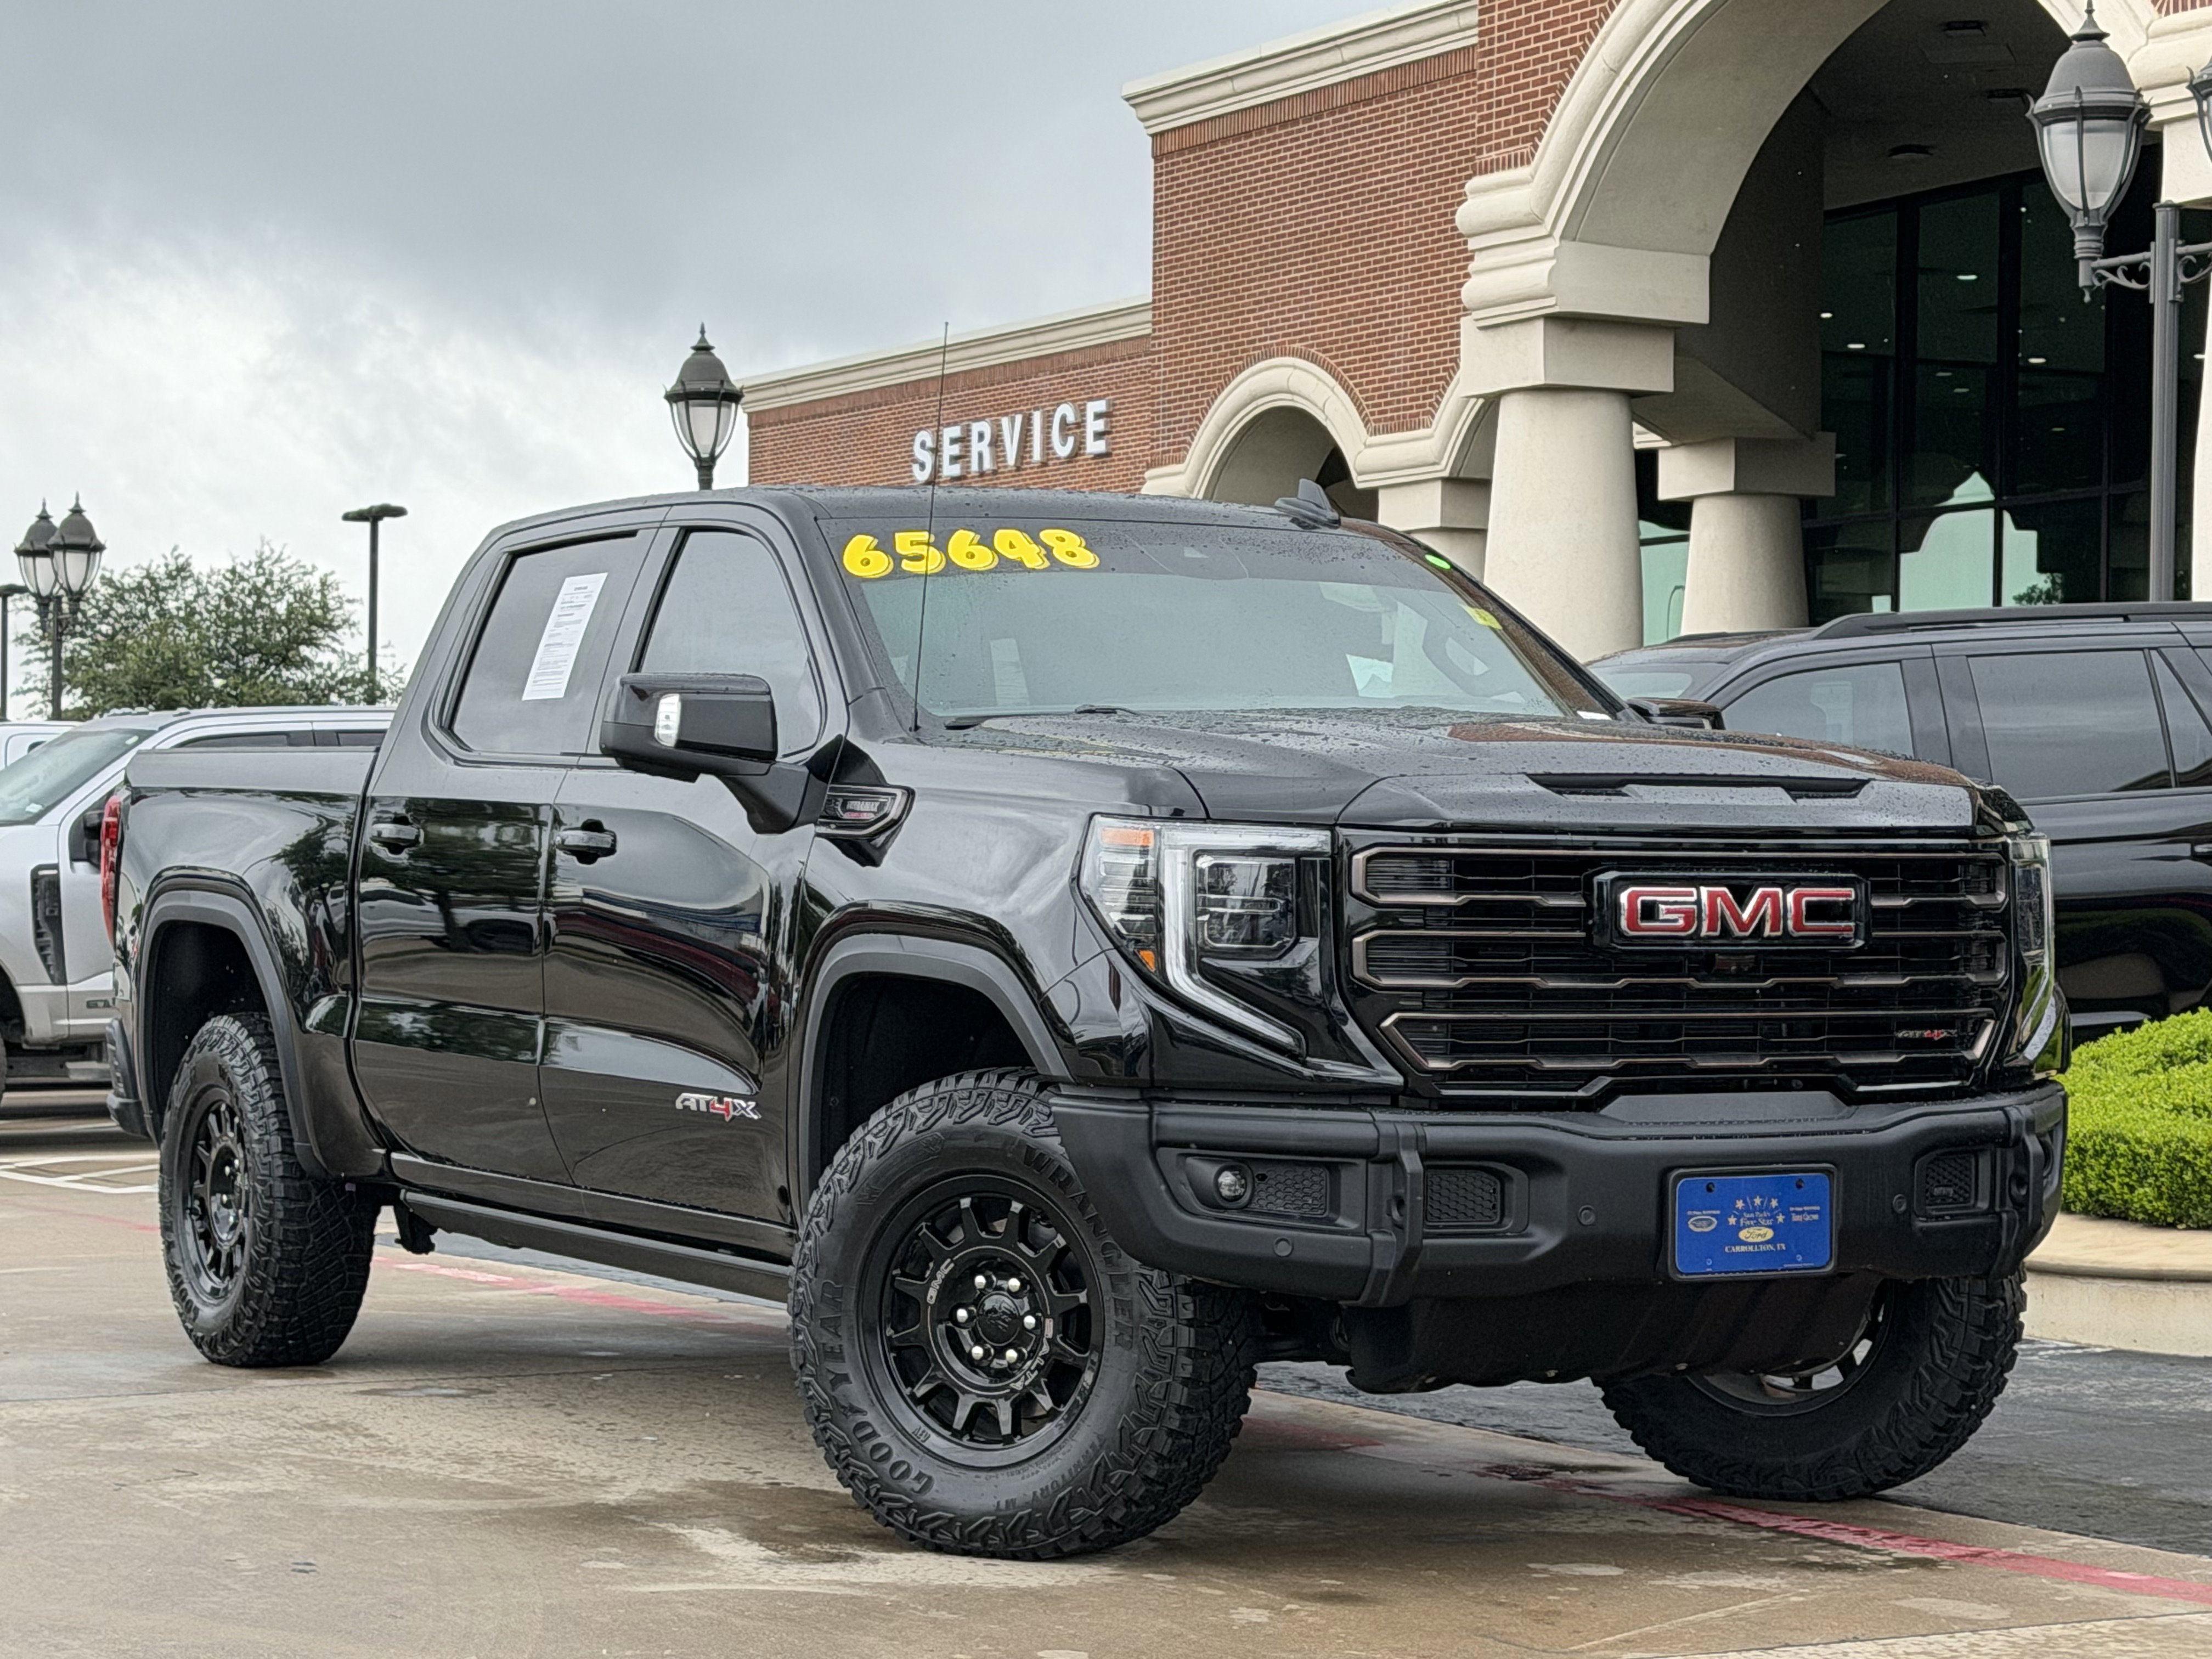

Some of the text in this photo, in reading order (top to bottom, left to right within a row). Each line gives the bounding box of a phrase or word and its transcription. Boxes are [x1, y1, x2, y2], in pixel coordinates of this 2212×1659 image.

[912, 398, 1111, 484] SERVICE
[843, 528, 1100, 578] 65648
[1620, 885, 1855, 939] GMC
[675, 1092, 762, 1122] AT4X
[1744, 1229, 1769, 1239] Ford
[927, 1258, 955, 1305] GMC
[820, 1279, 934, 1496] GOODYEAR
